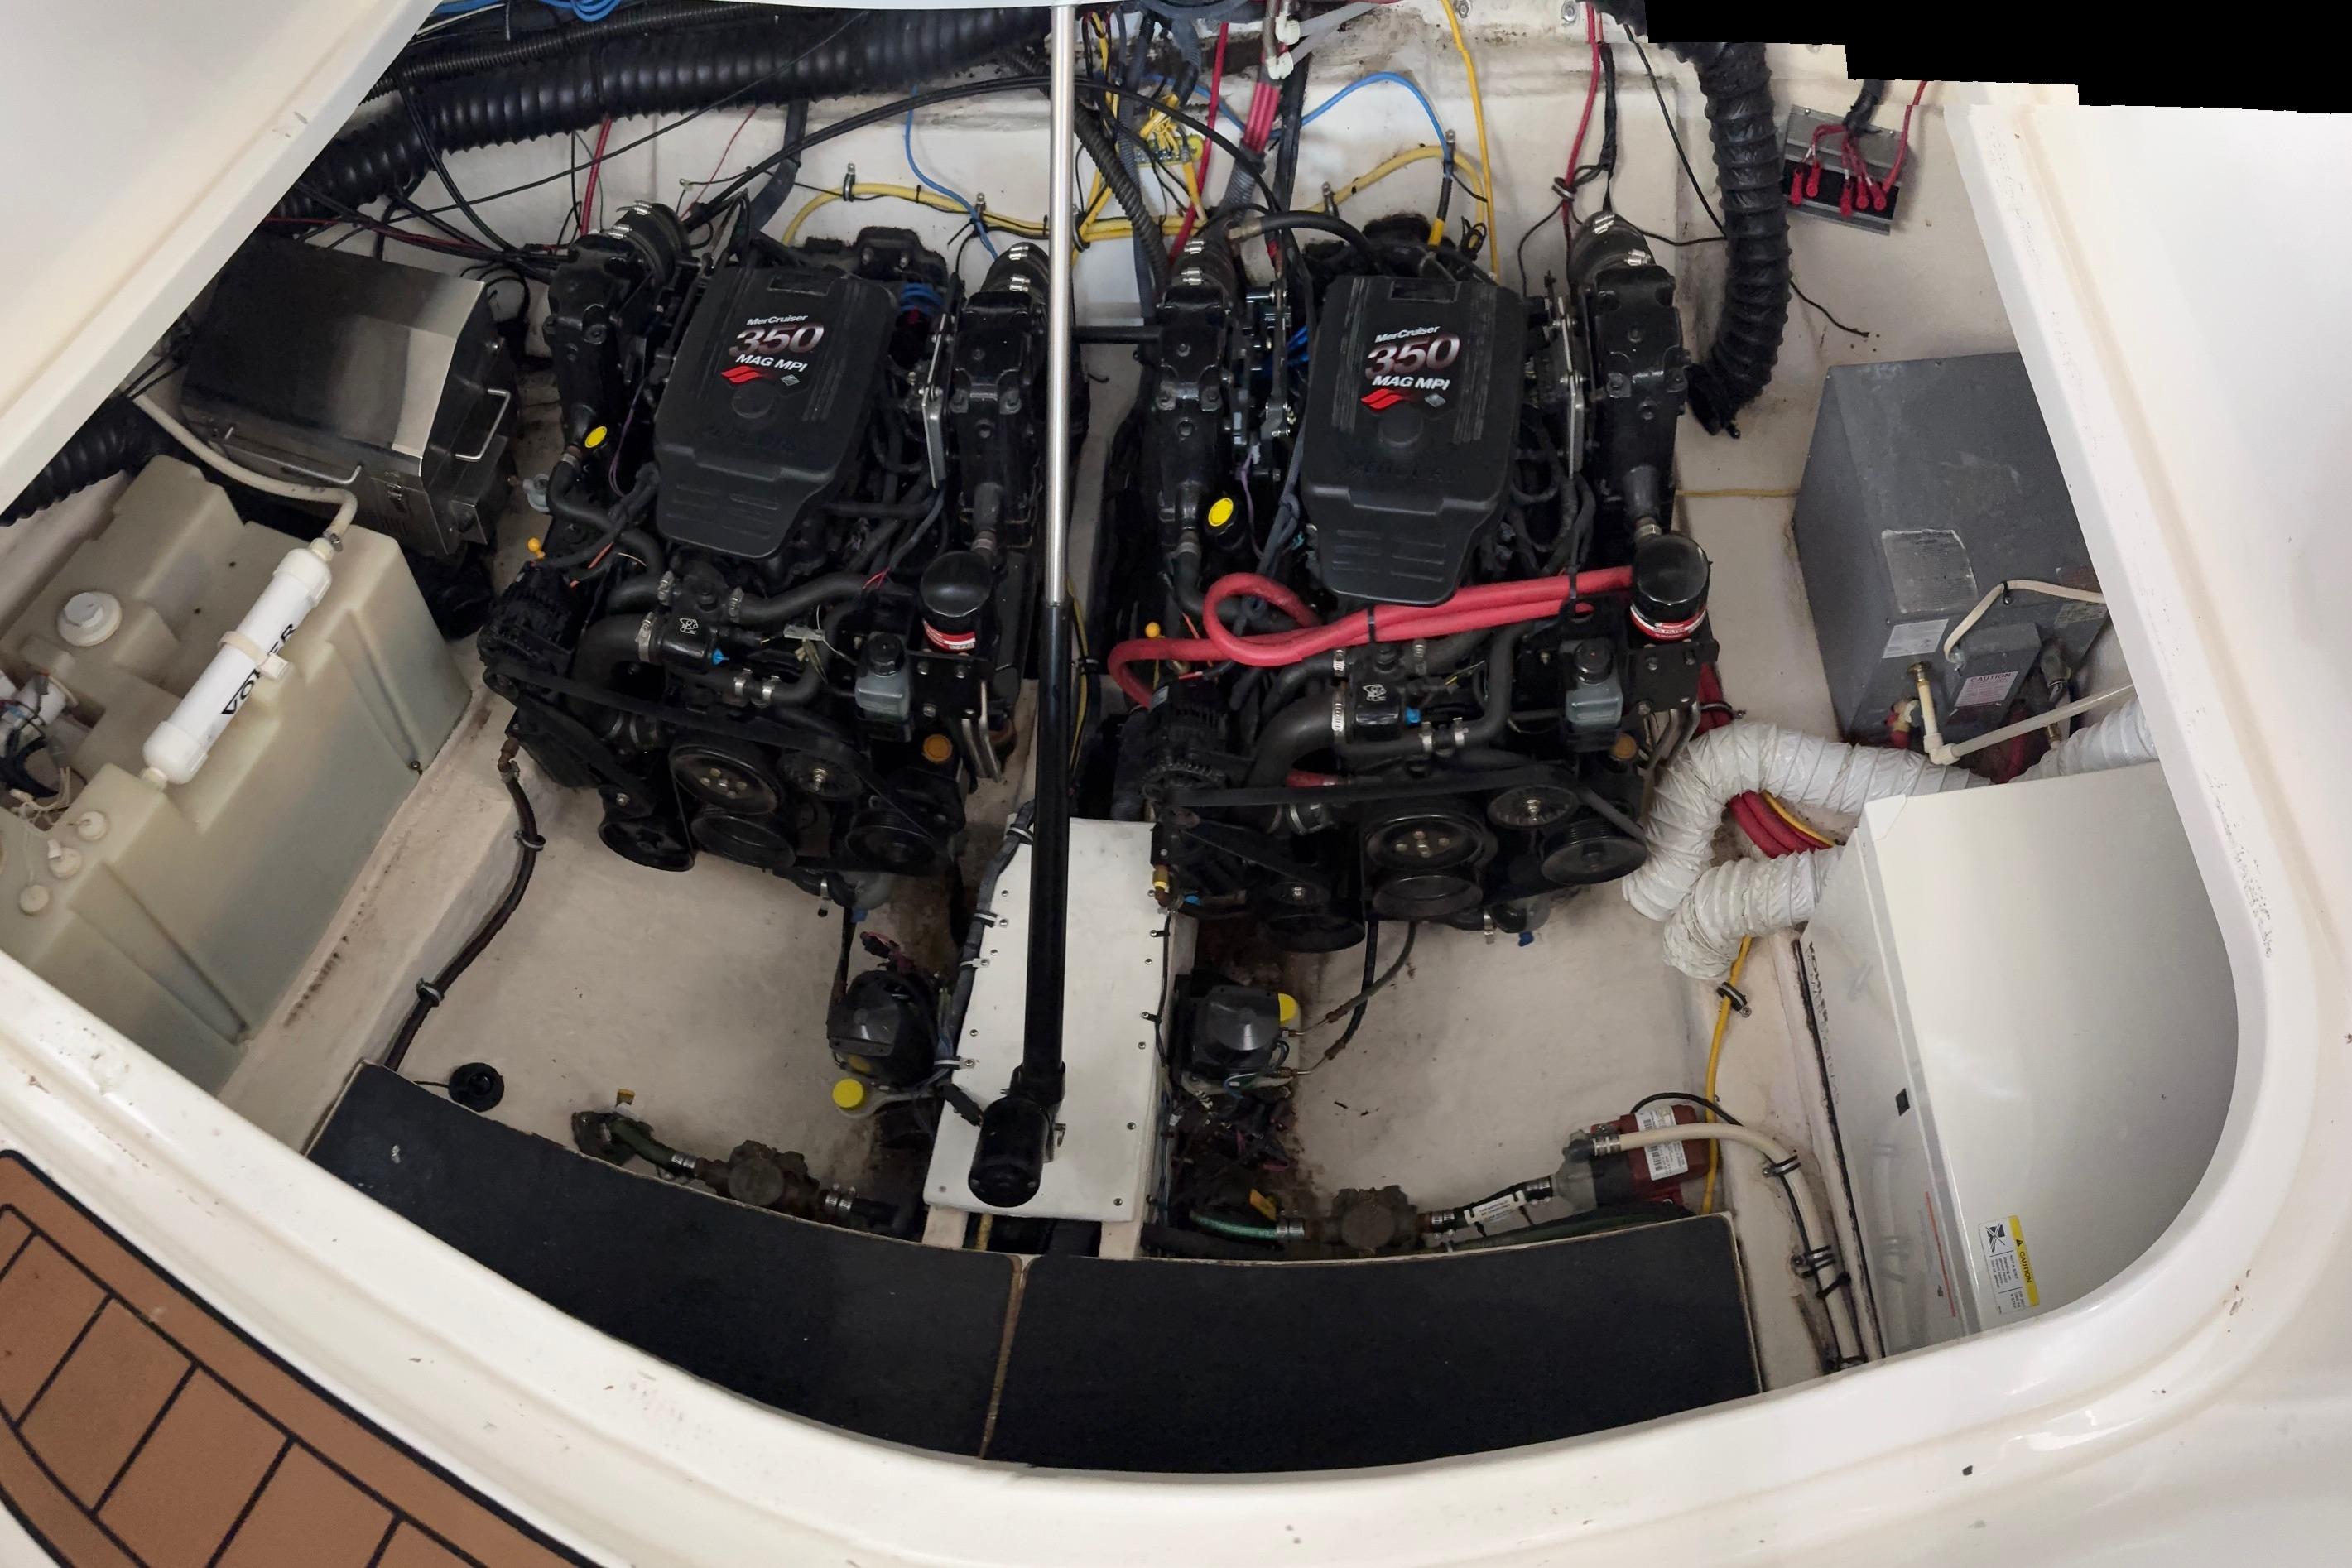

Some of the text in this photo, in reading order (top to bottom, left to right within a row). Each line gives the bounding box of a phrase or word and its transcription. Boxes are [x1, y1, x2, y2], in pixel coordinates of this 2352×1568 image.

[746, 315, 809, 326] MerCruiser
[729, 323, 825, 358] 350
[1374, 326, 1440, 343] MerCruiser
[735, 354, 808, 372] MAG MPI
[1364, 334, 1460, 379] 350
[1372, 375, 1450, 391] MAG MPI
[1970, 673, 2011, 682] CAUTION
[2020, 1252, 2032, 1283] CAUTION
